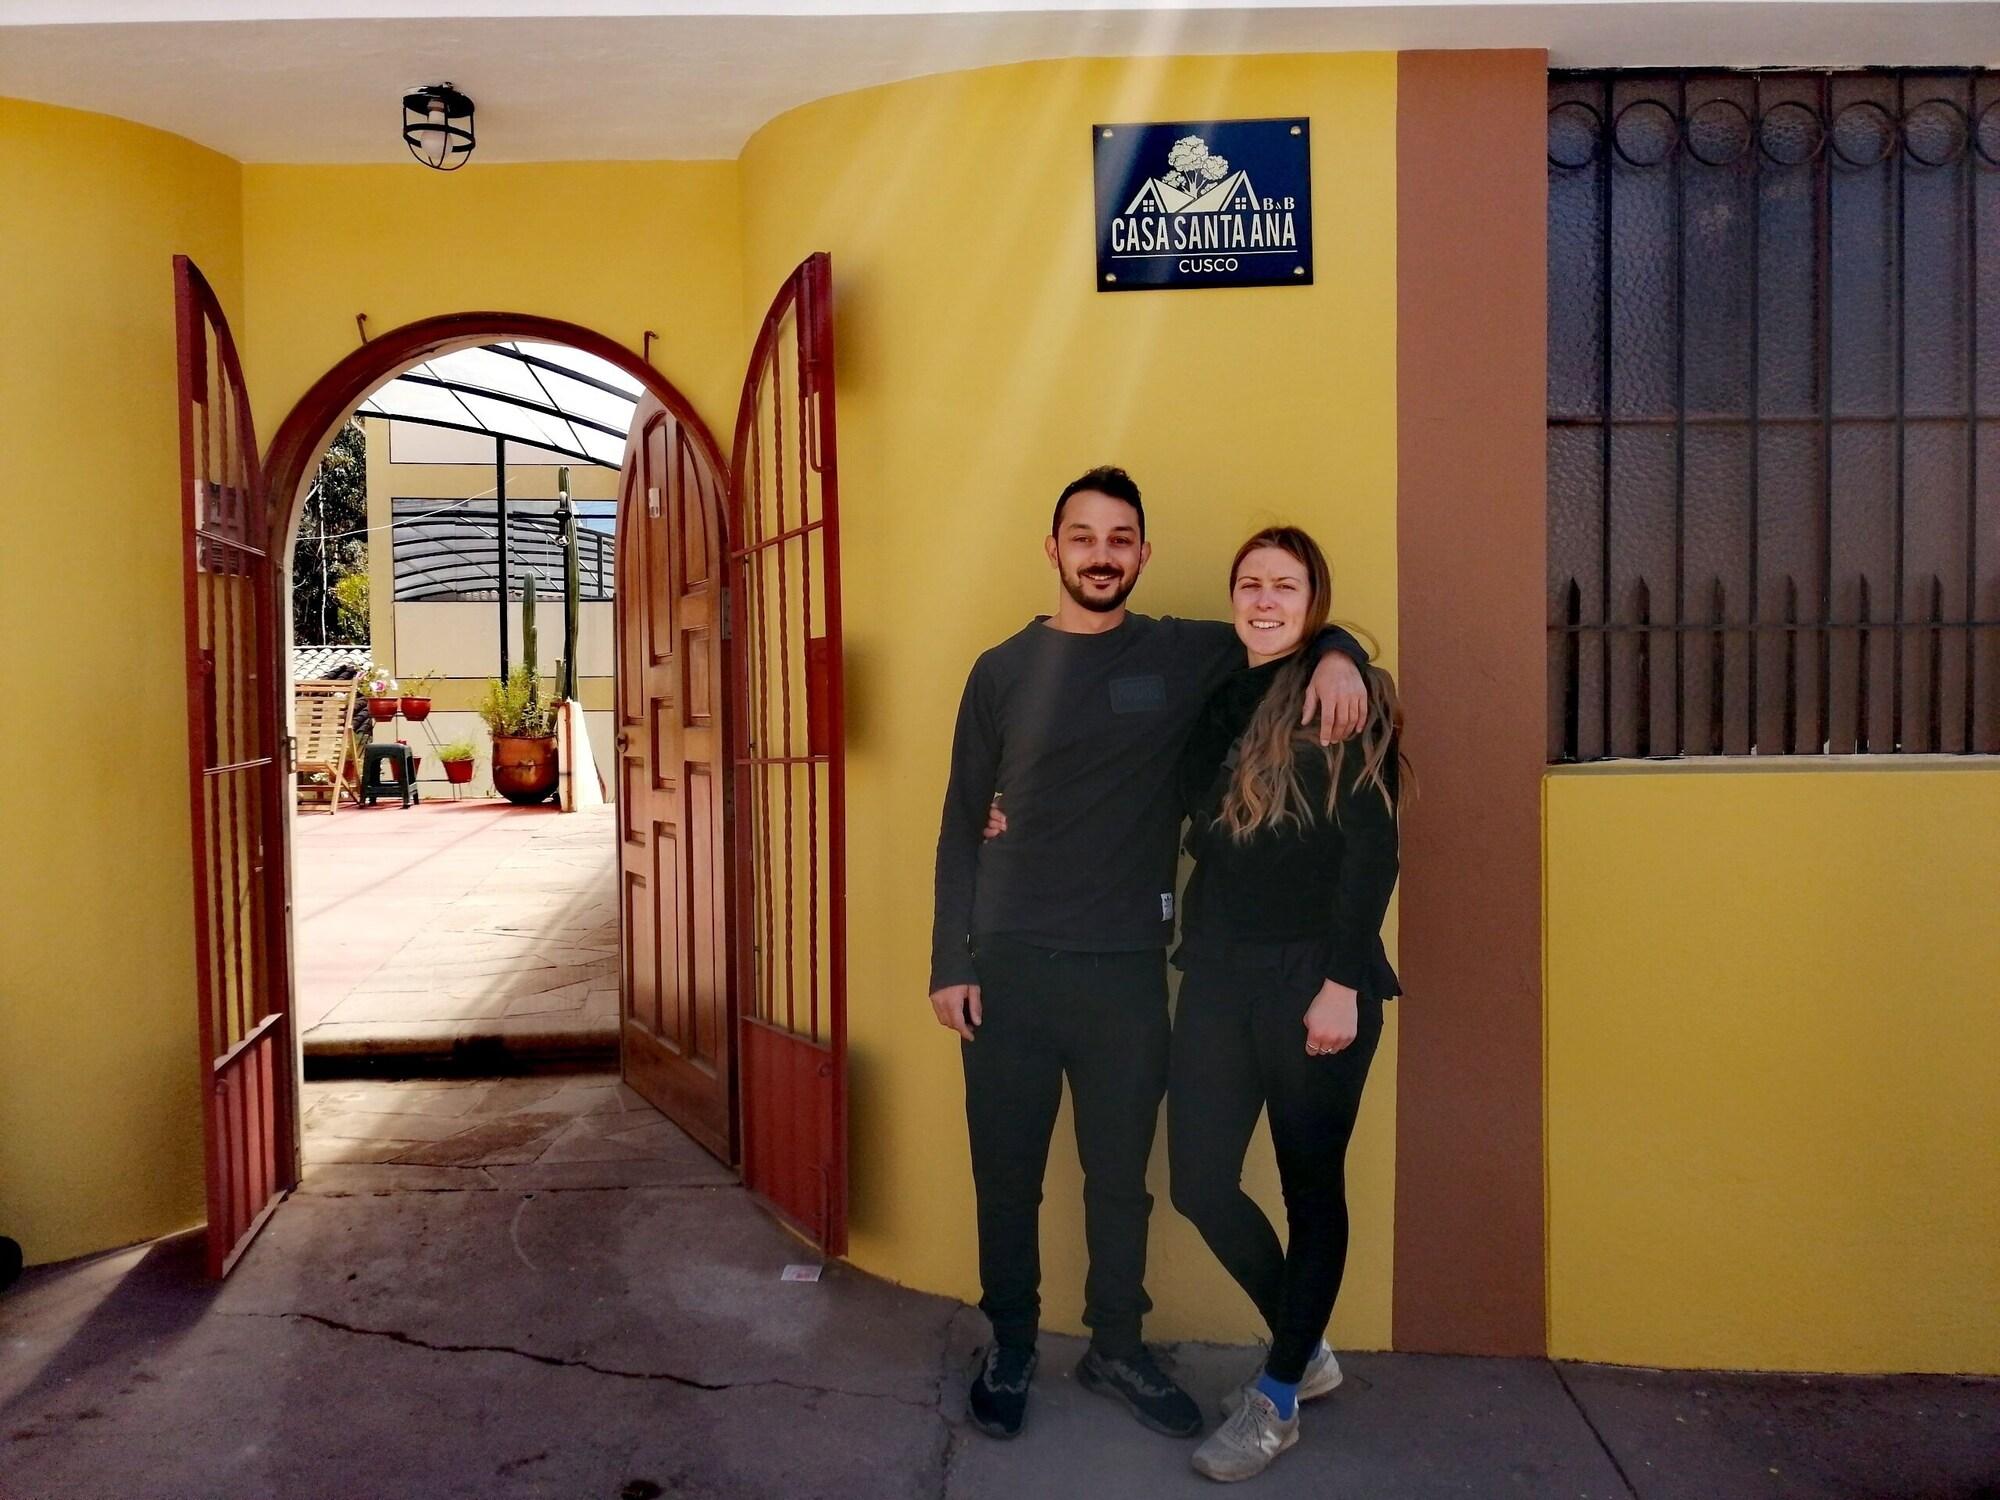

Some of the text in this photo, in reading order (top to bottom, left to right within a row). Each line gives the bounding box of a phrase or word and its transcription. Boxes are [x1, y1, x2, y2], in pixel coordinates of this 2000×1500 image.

[1263, 196, 1295, 210] B&B
[1112, 212, 1296, 252] CASA SANTA ANA
[1179, 258, 1238, 273] CUSCO
